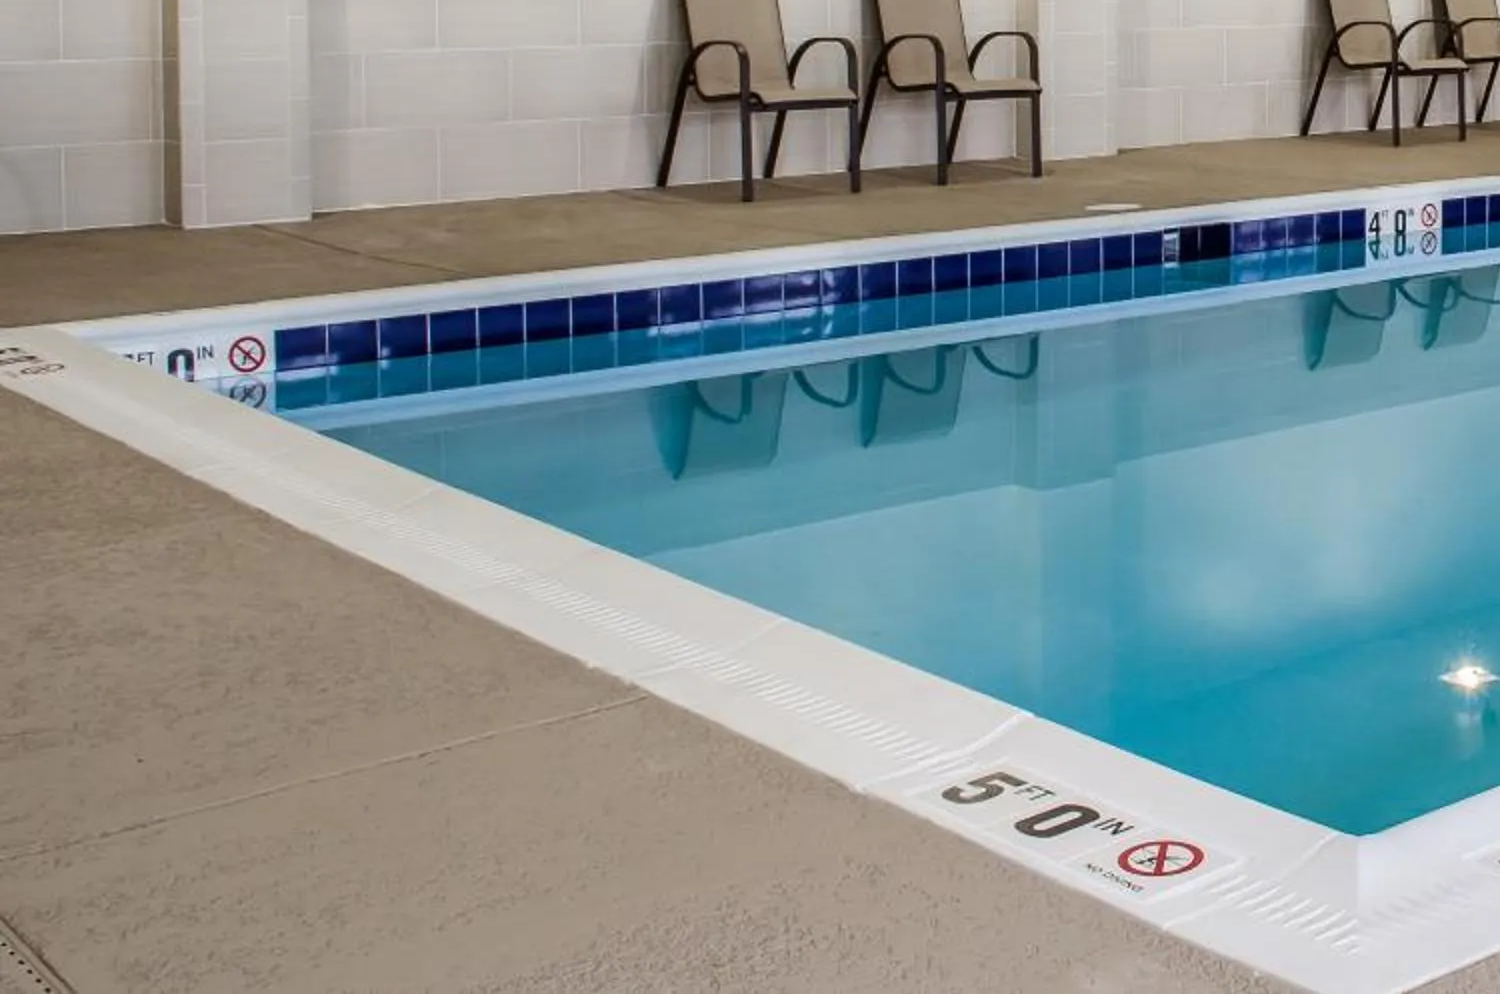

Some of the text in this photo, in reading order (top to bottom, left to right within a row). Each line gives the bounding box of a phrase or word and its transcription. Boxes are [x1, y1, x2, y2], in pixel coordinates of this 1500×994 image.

[1368, 211, 1381, 235] 4
[197, 344, 215, 359] IN
[941, 771, 1135, 838] 5 FT 0 IN
